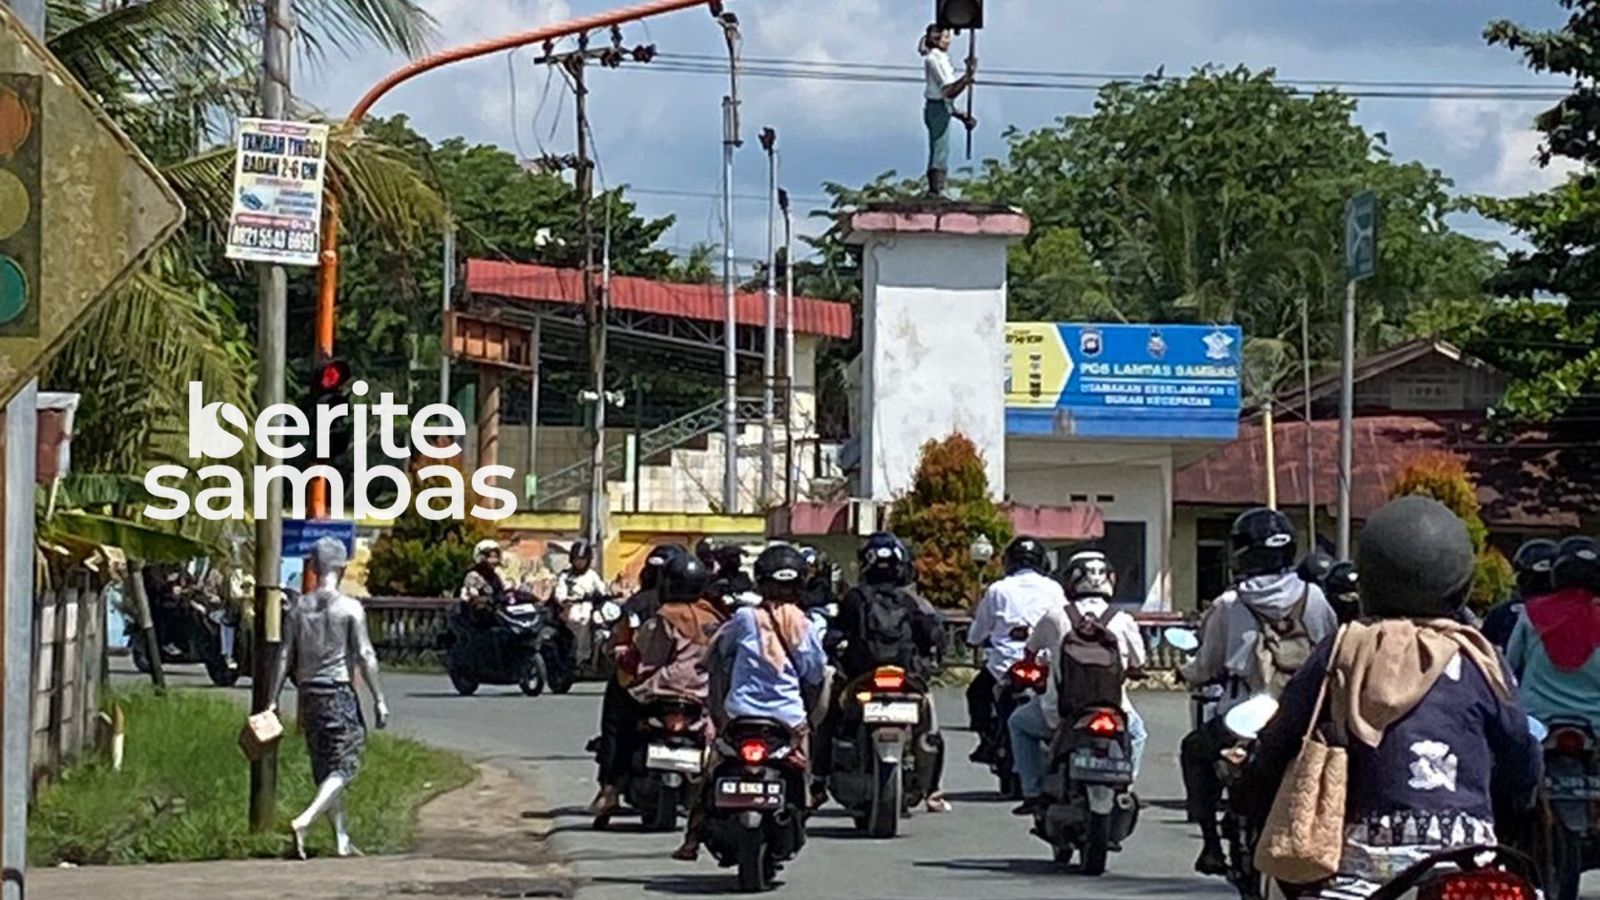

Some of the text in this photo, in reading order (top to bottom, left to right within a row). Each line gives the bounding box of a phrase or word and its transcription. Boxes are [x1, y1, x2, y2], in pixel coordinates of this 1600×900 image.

[242, 133, 321, 157] TAMBAH TINGGI
[242, 154, 318, 180] BADAN 2-6 CM
[1079, 363, 1237, 378] POS LANTAS SAMBAS
[1080, 383, 1142, 394] UTAMAKAN
[1144, 385, 1225, 396] KESELAMATAN
[1104, 395, 1211, 407] BUKAN KECEPATAN
